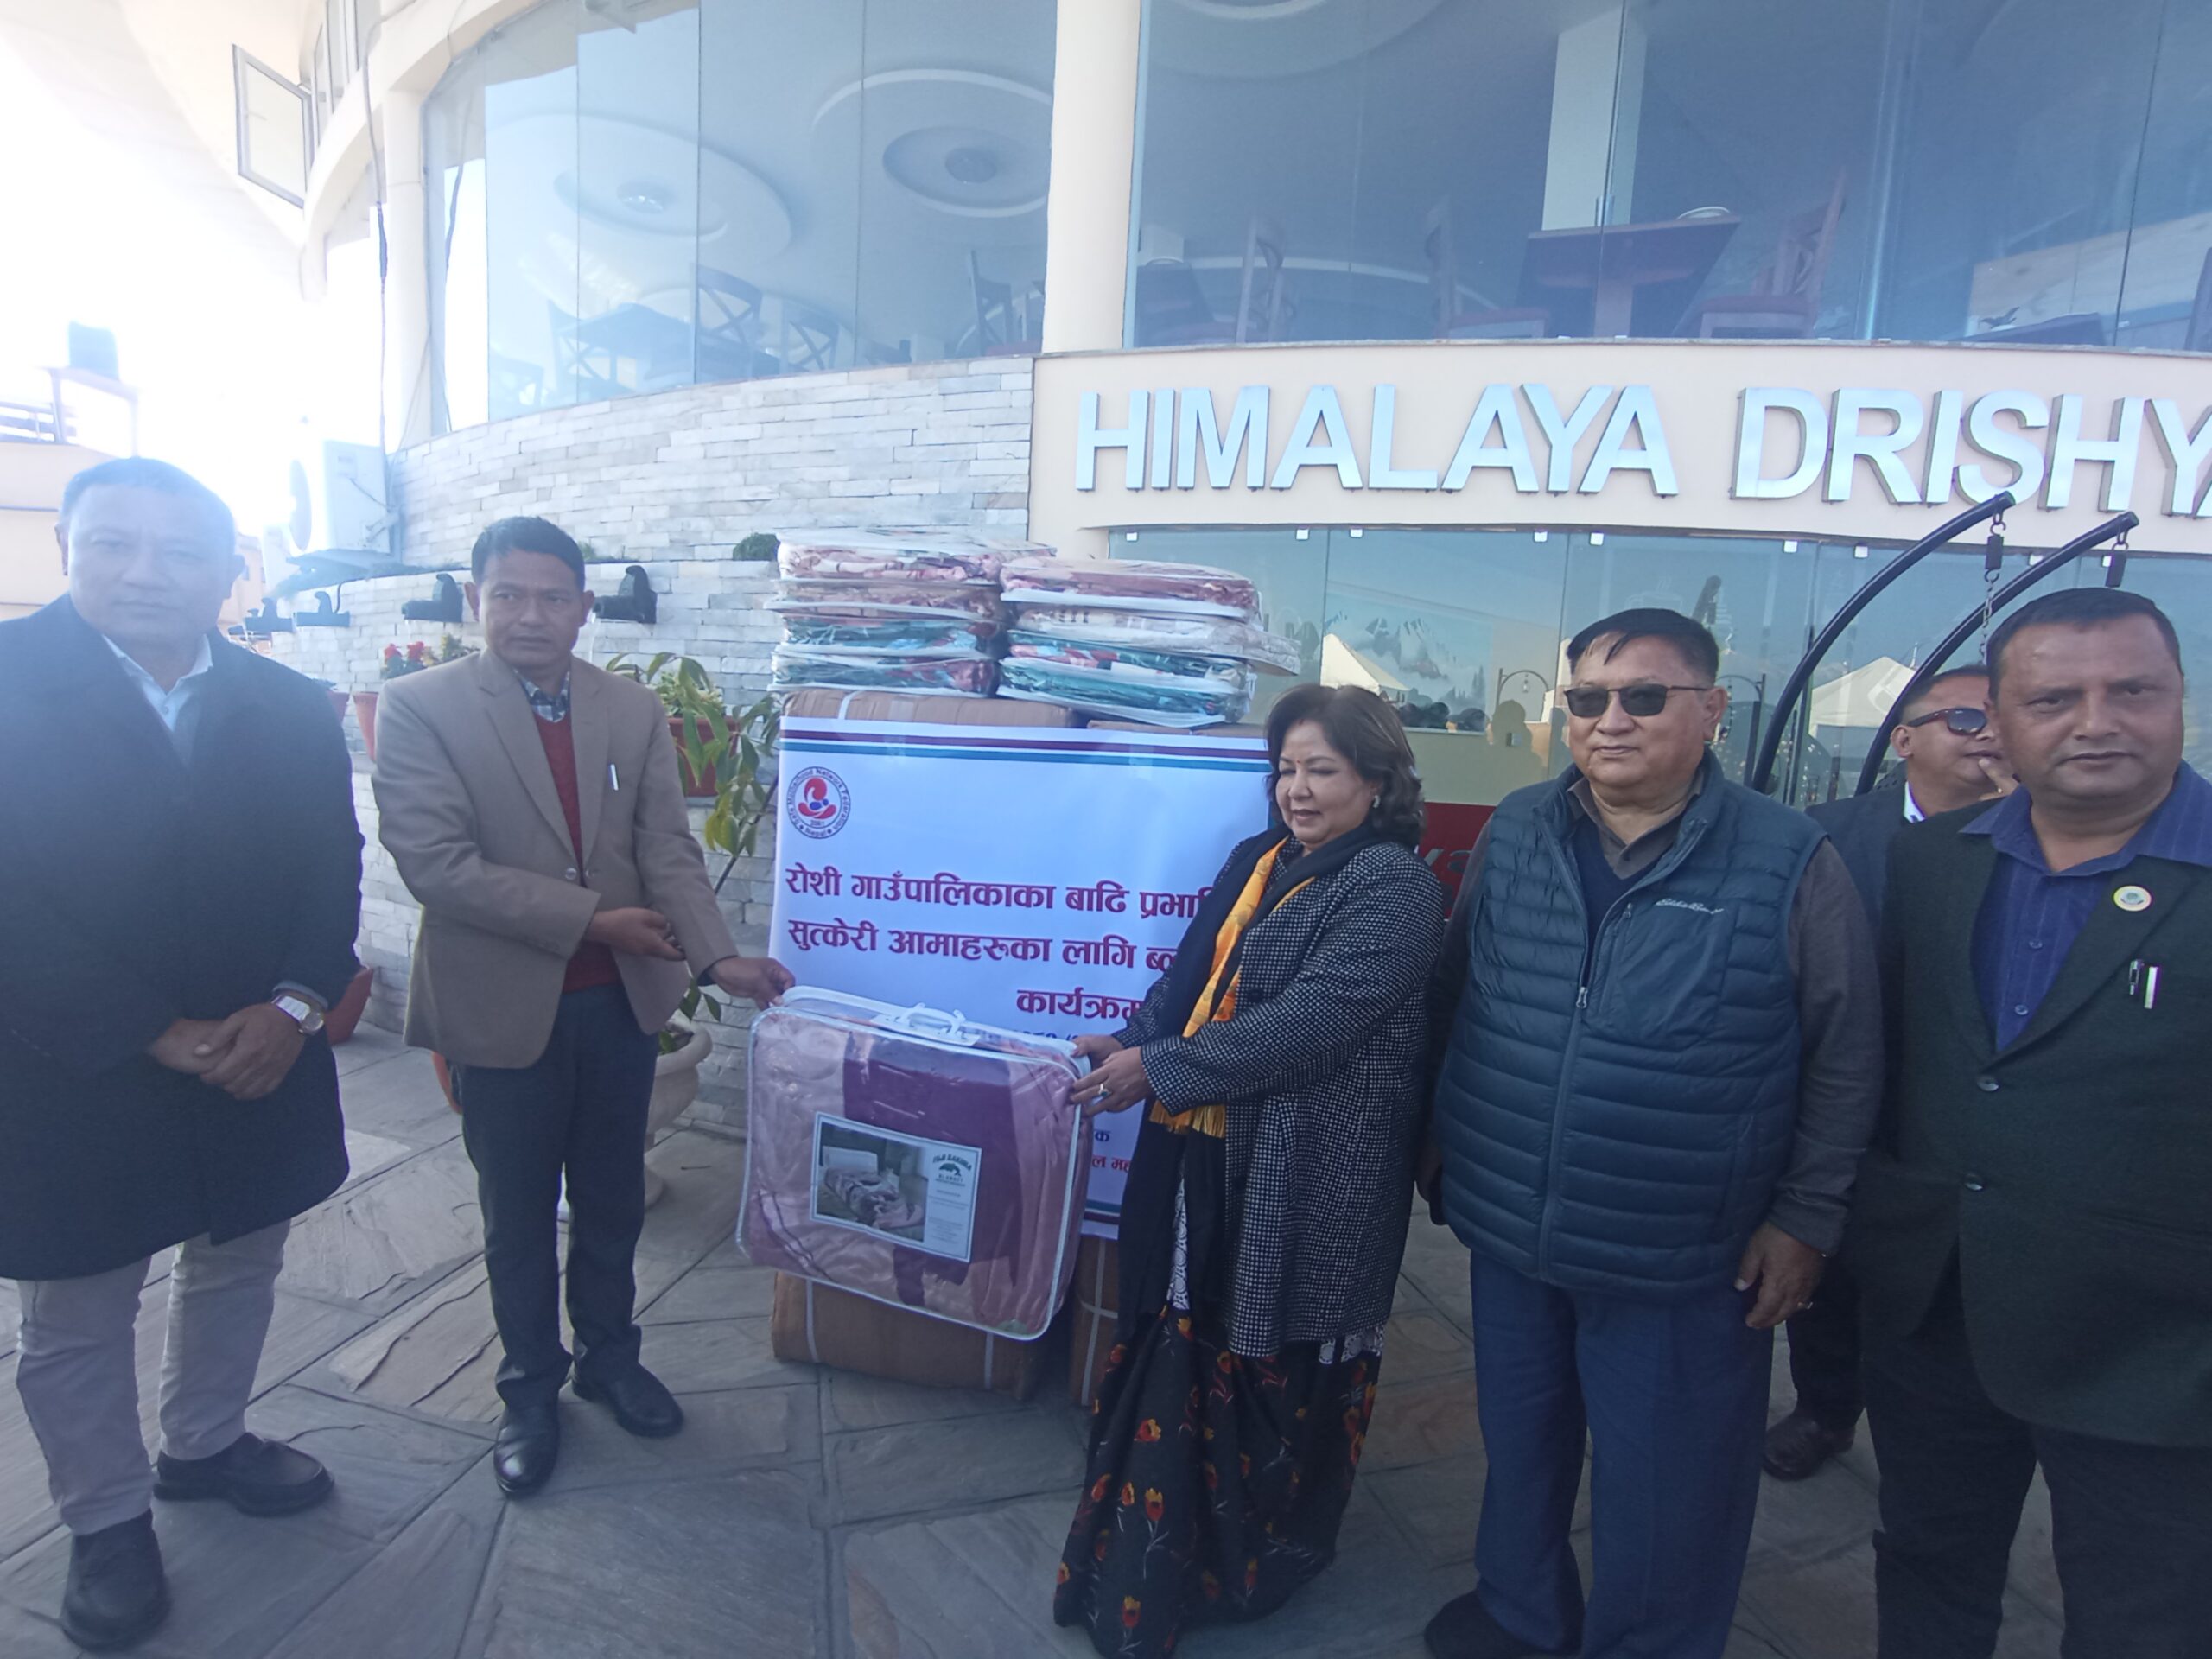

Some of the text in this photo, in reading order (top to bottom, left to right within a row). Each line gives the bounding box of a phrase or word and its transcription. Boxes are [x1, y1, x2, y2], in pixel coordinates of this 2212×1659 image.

[1076, 385, 1679, 499] HIMALAYA
[785, 862, 842, 896] रोशी
[851, 870, 1056, 909] गाउँपालिकाका
[1065, 880, 1130, 913] बाढि
[788, 918, 879, 951] सुत्केरी
[1062, 934, 1137, 969] लागि
